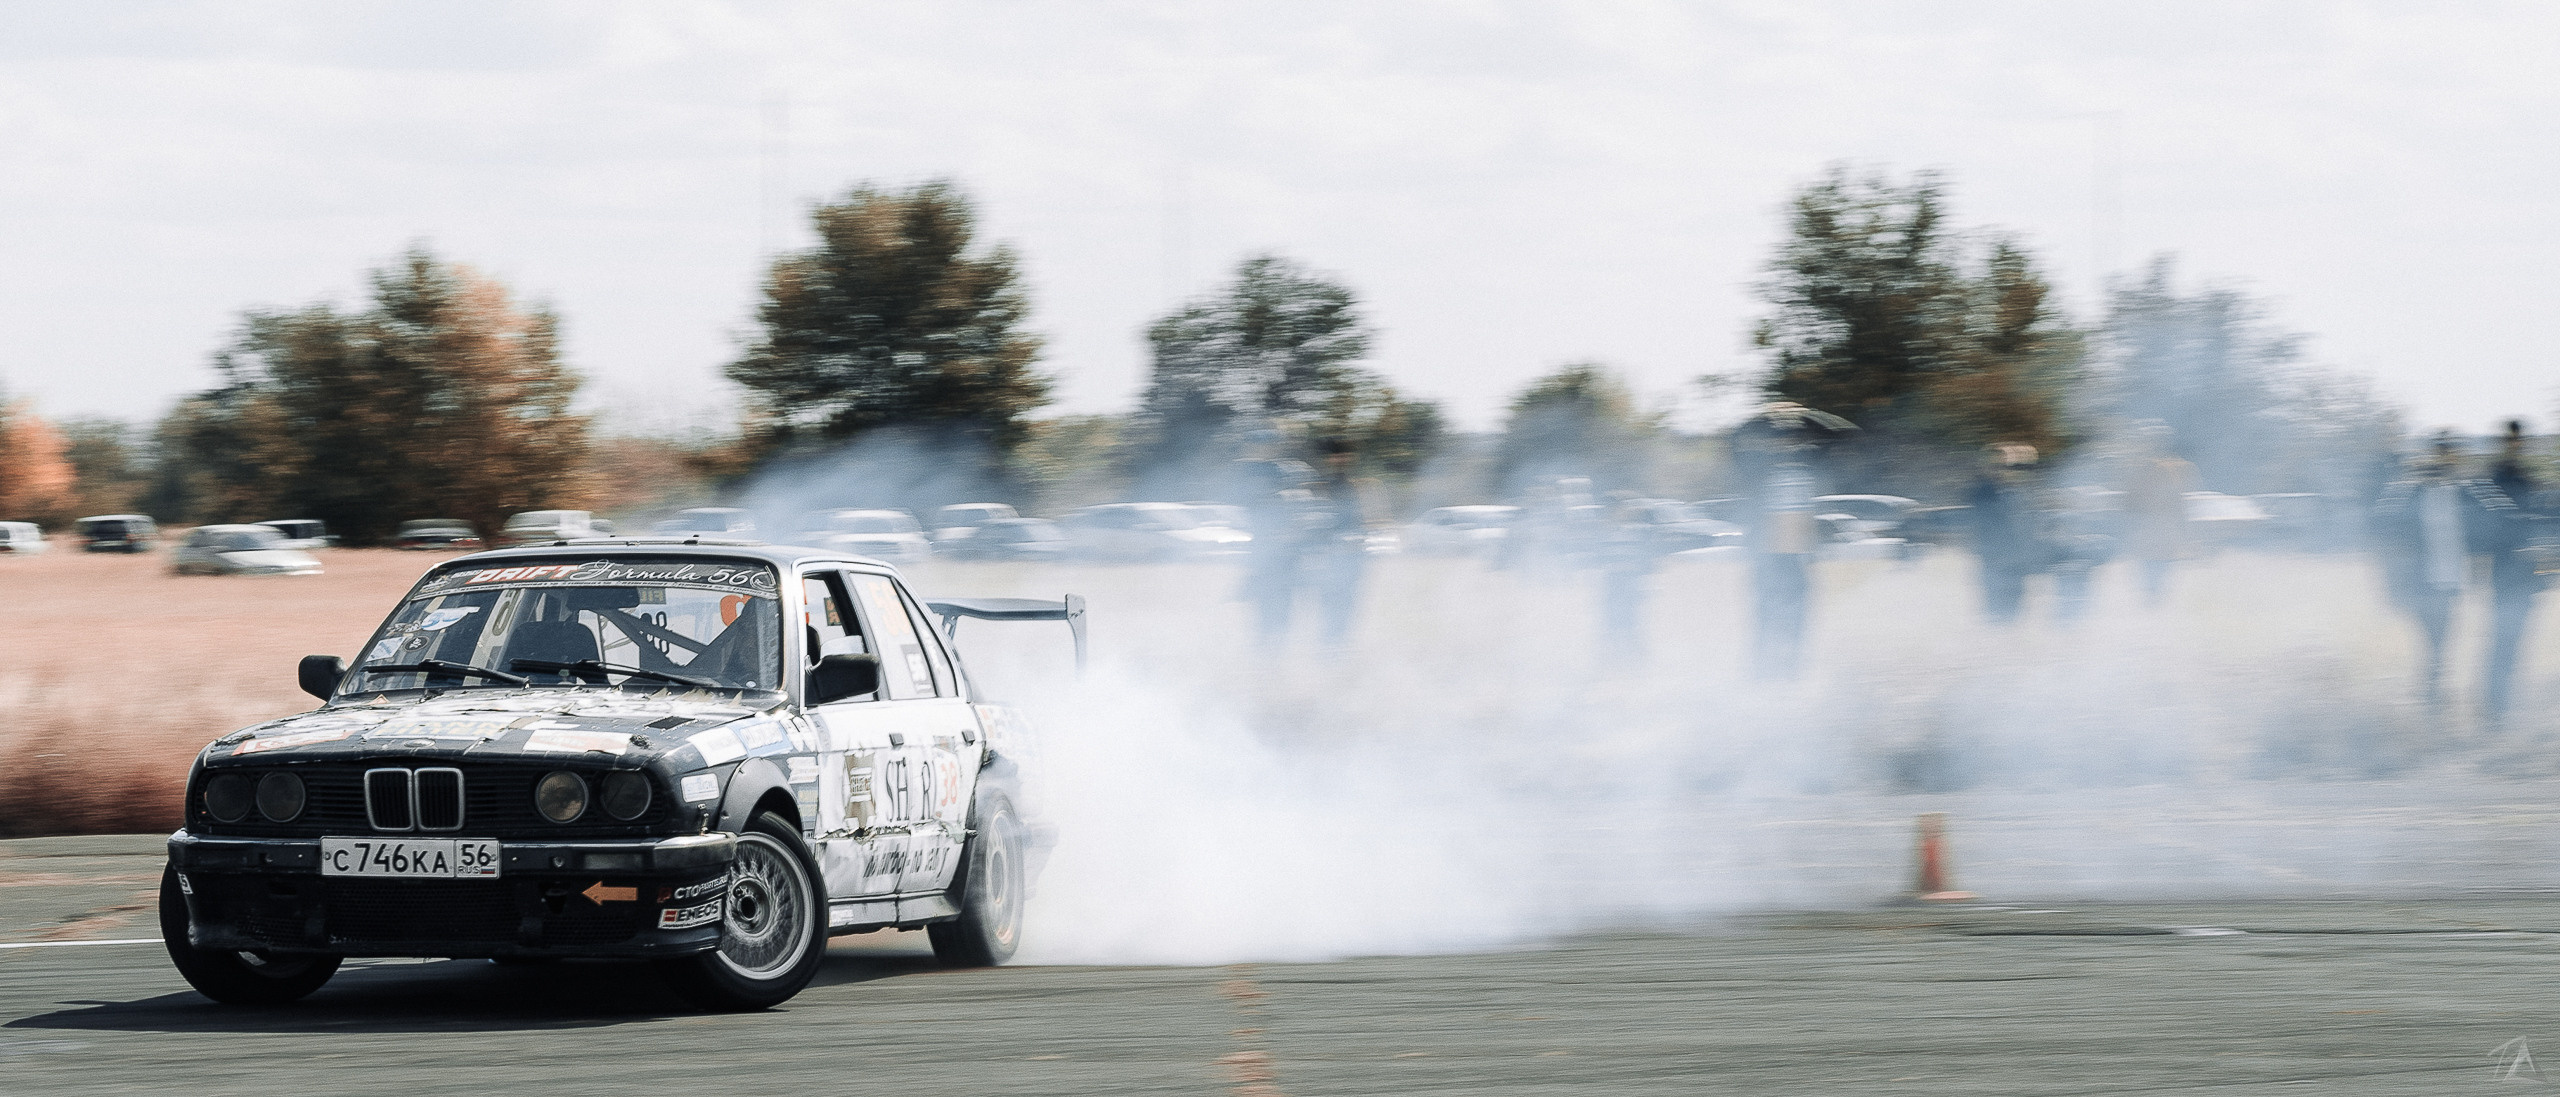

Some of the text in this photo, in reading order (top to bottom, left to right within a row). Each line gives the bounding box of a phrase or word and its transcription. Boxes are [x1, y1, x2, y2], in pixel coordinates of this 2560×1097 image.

[466, 565, 579, 585] DRIFT
[570, 559, 701, 581] Formula
[458, 866, 480, 875] RUS
[678, 901, 720, 922] ENEOS
